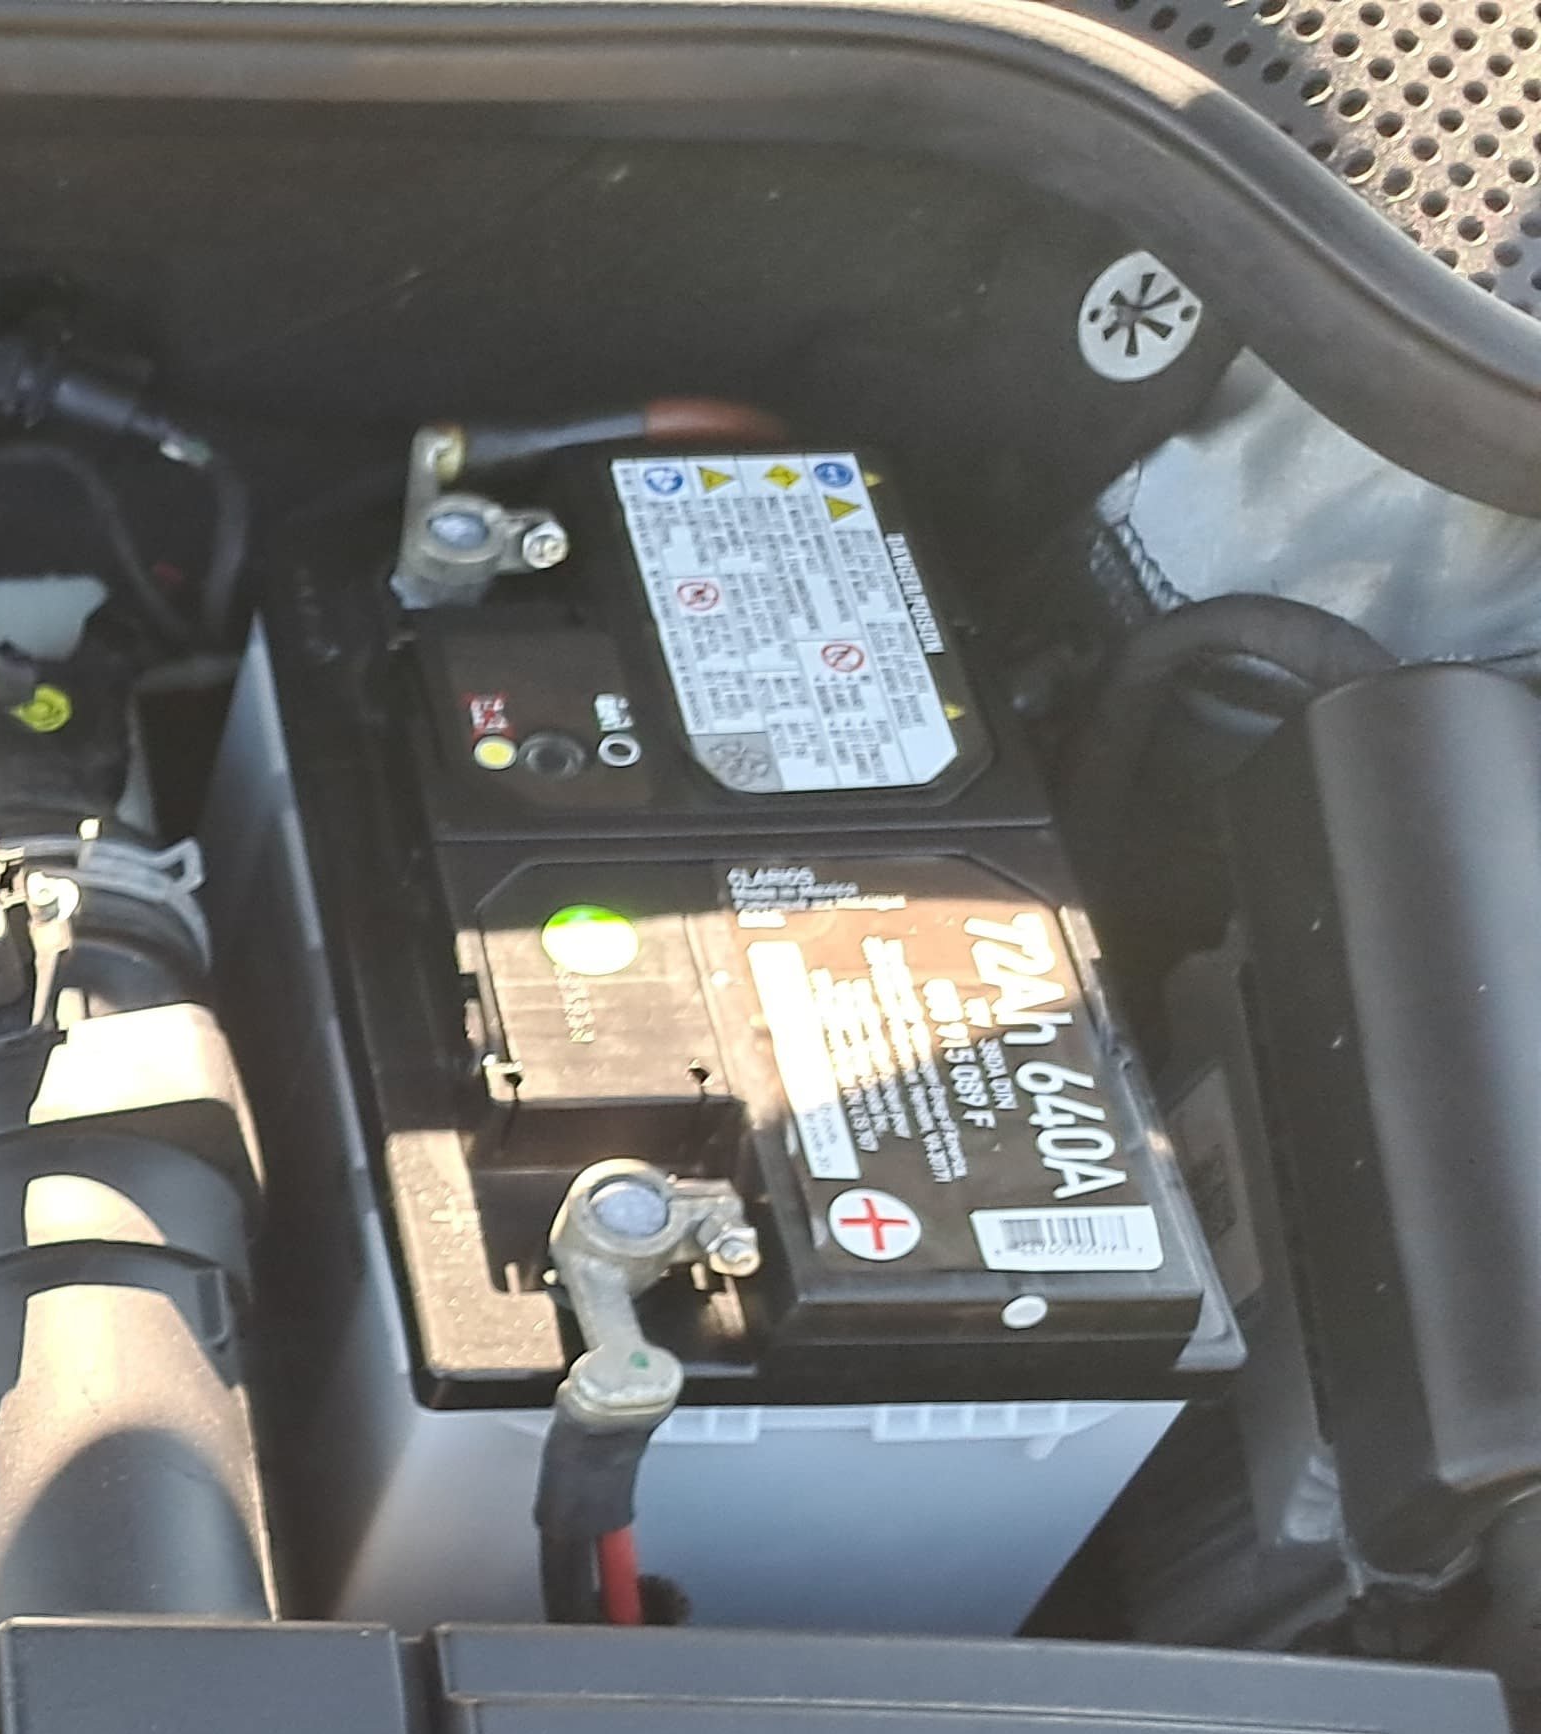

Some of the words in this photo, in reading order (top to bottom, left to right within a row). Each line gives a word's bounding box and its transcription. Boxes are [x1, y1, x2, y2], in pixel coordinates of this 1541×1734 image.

[963, 912, 1074, 1045] 72Ah
[962, 1109, 998, 1130] F
[1015, 1060, 1128, 1199] 640A
